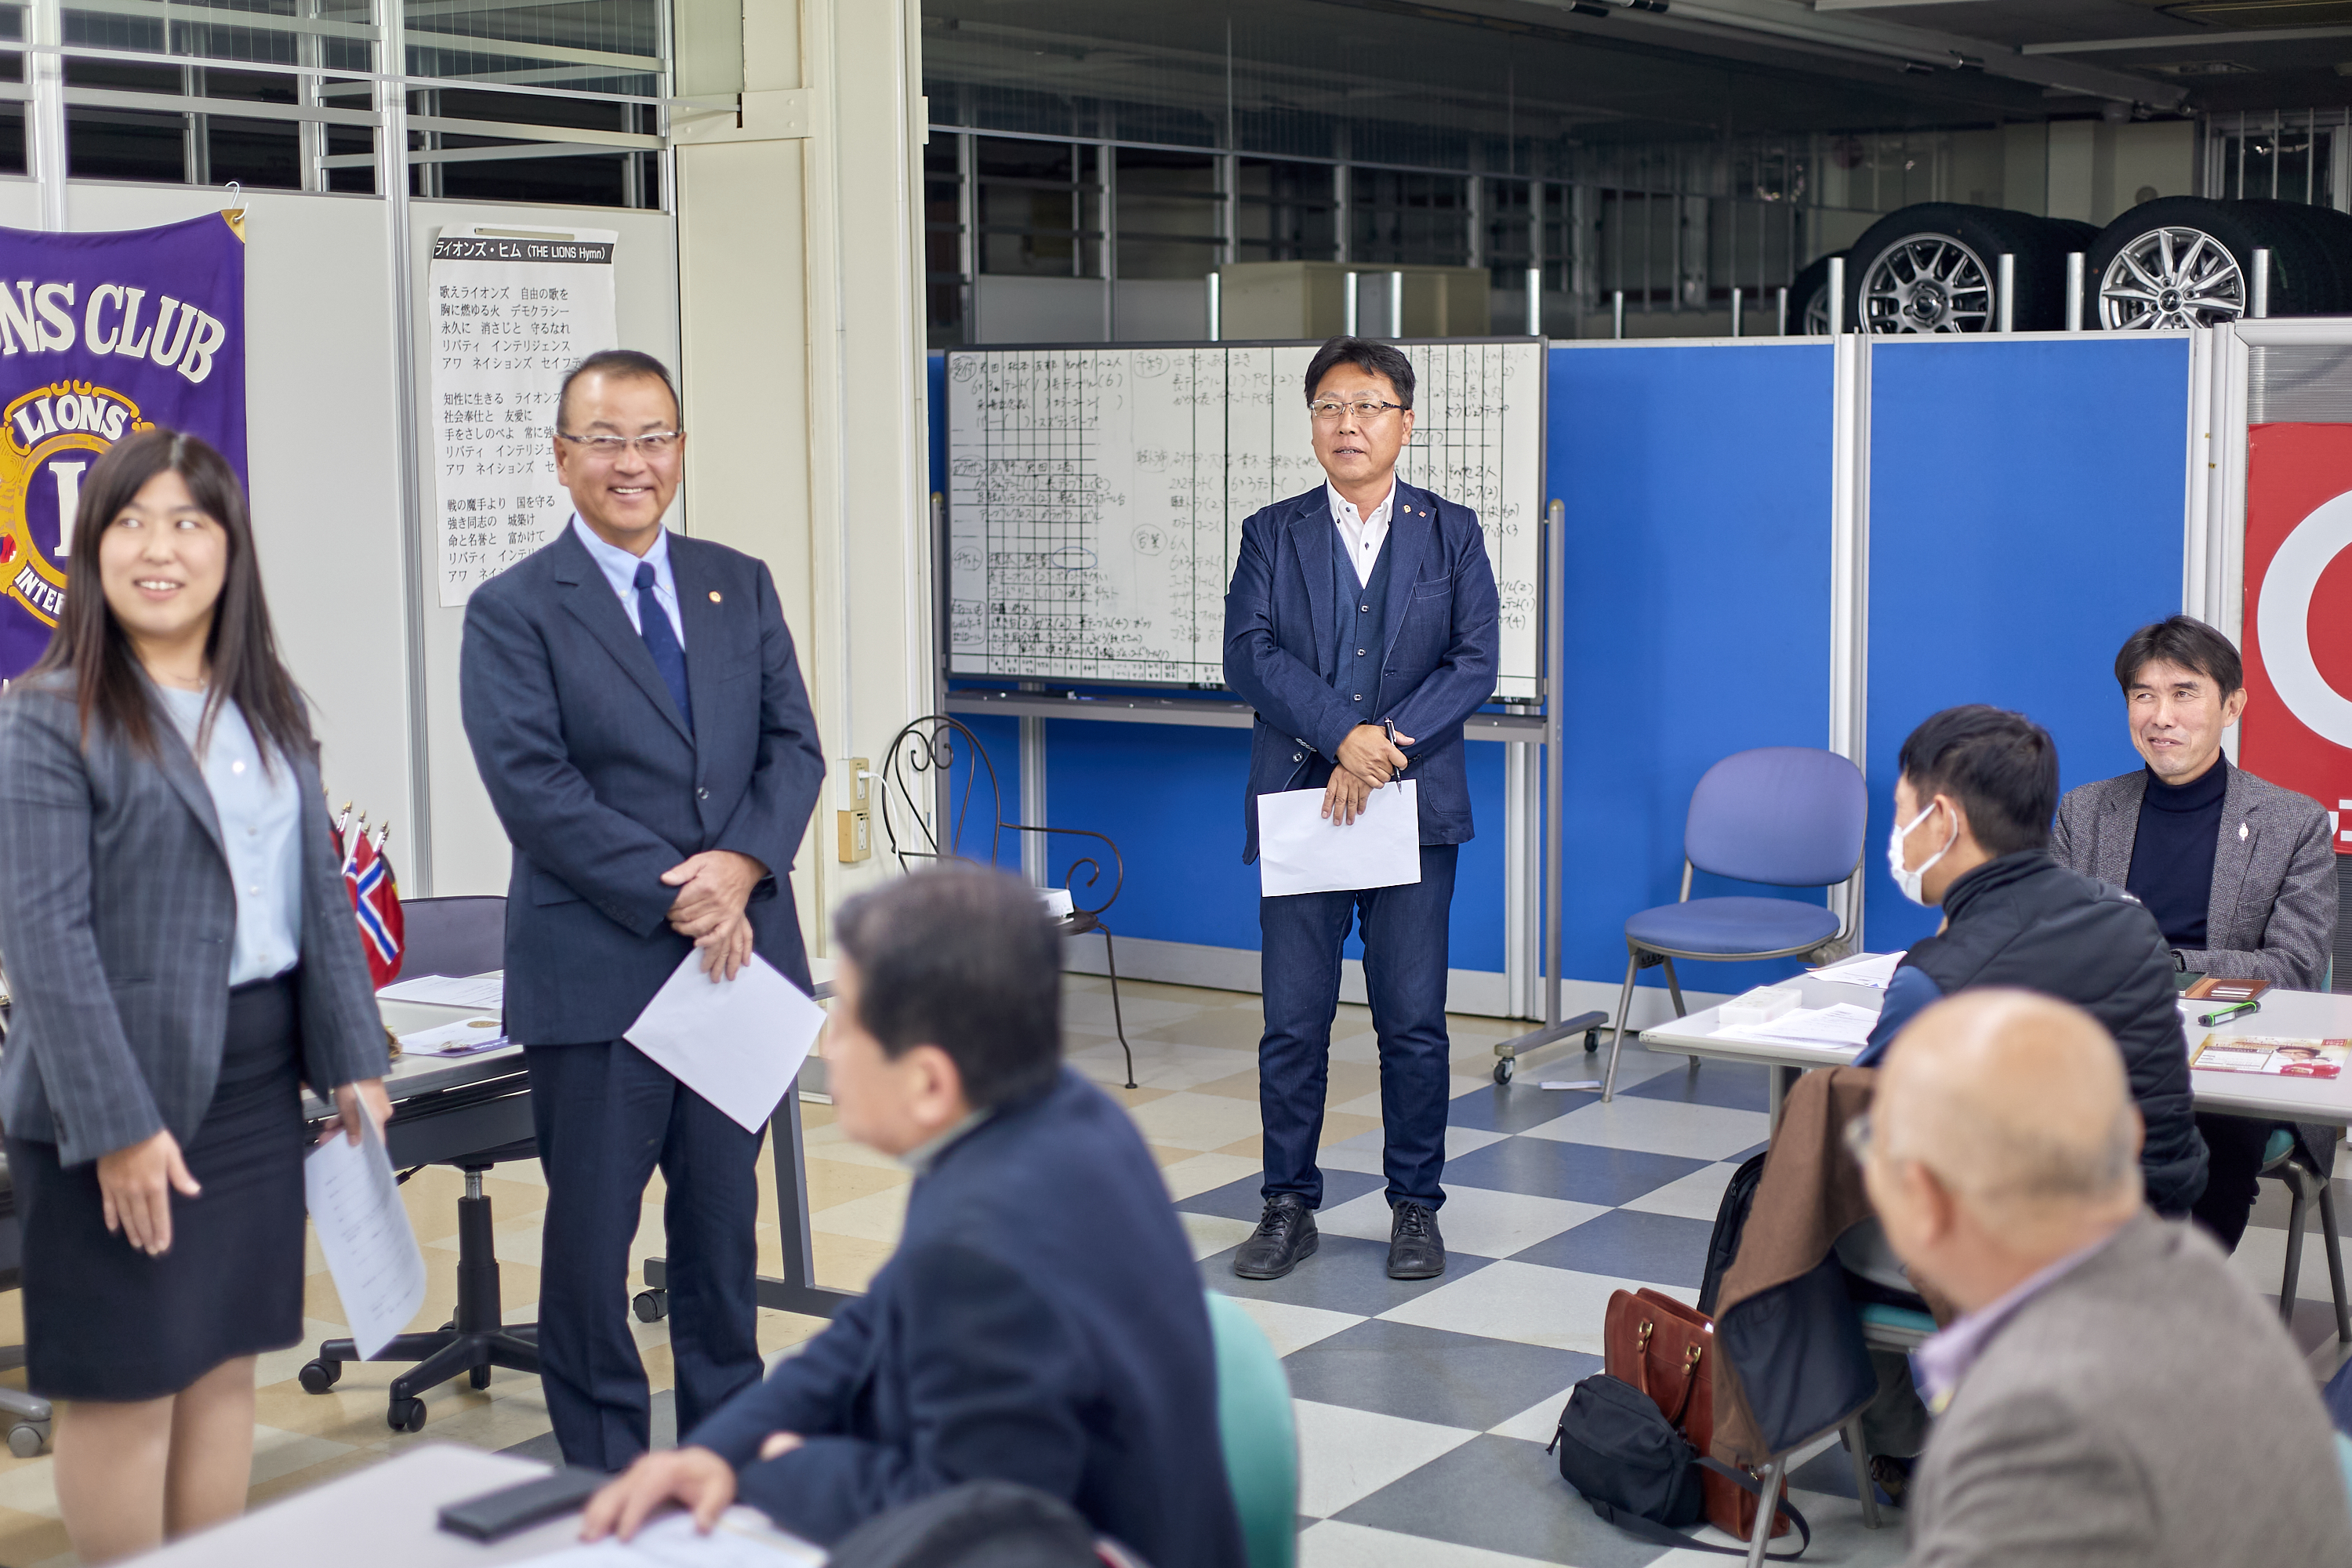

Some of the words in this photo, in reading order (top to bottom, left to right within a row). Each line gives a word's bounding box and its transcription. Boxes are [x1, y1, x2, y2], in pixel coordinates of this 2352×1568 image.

[434, 240, 522, 258] ライオンズ・ヒム
[551, 245, 577, 258] LIONS
[440, 285, 510, 300] 歌えライオンズ
[521, 287, 569, 301] 自由の歌を
[441, 303, 500, 318] 胸に燃ゆる火
[510, 304, 569, 318] デモクラシー
[0, 281, 76, 355] NS
[85, 284, 226, 383] CLUB
[441, 321, 470, 335] 永久に
[481, 321, 521, 335] 消さじと
[531, 321, 571, 335] 守るなれ
[443, 339, 480, 353] リバティ
[492, 340, 571, 352] インテリジェンス
[442, 358, 462, 369] アワ
[473, 358, 532, 369] ネイションズ
[444, 392, 504, 406] 知性に生きる
[13, 394, 129, 445] LIONS
[444, 410, 494, 423] 社会奉仕と
[504, 409, 532, 423] 友愛に
[445, 428, 514, 441] 手をさしのべよ
[524, 426, 554, 439] 常に強
[446, 445, 483, 459] リバティ
[495, 444, 554, 457] インテリジェ
[446, 463, 465, 477] アワ
[476, 461, 535, 476] ネイションズ
[448, 497, 506, 512] 戦の魔手より
[517, 495, 556, 510] 国を守る
[448, 515, 497, 530] 強き同志の
[508, 514, 535, 527] 城築け
[448, 533, 497, 547] 命と名誉と
[508, 530, 546, 544] 富かけて
[449, 551, 486, 564] リバティ
[448, 570, 467, 583] アワ
